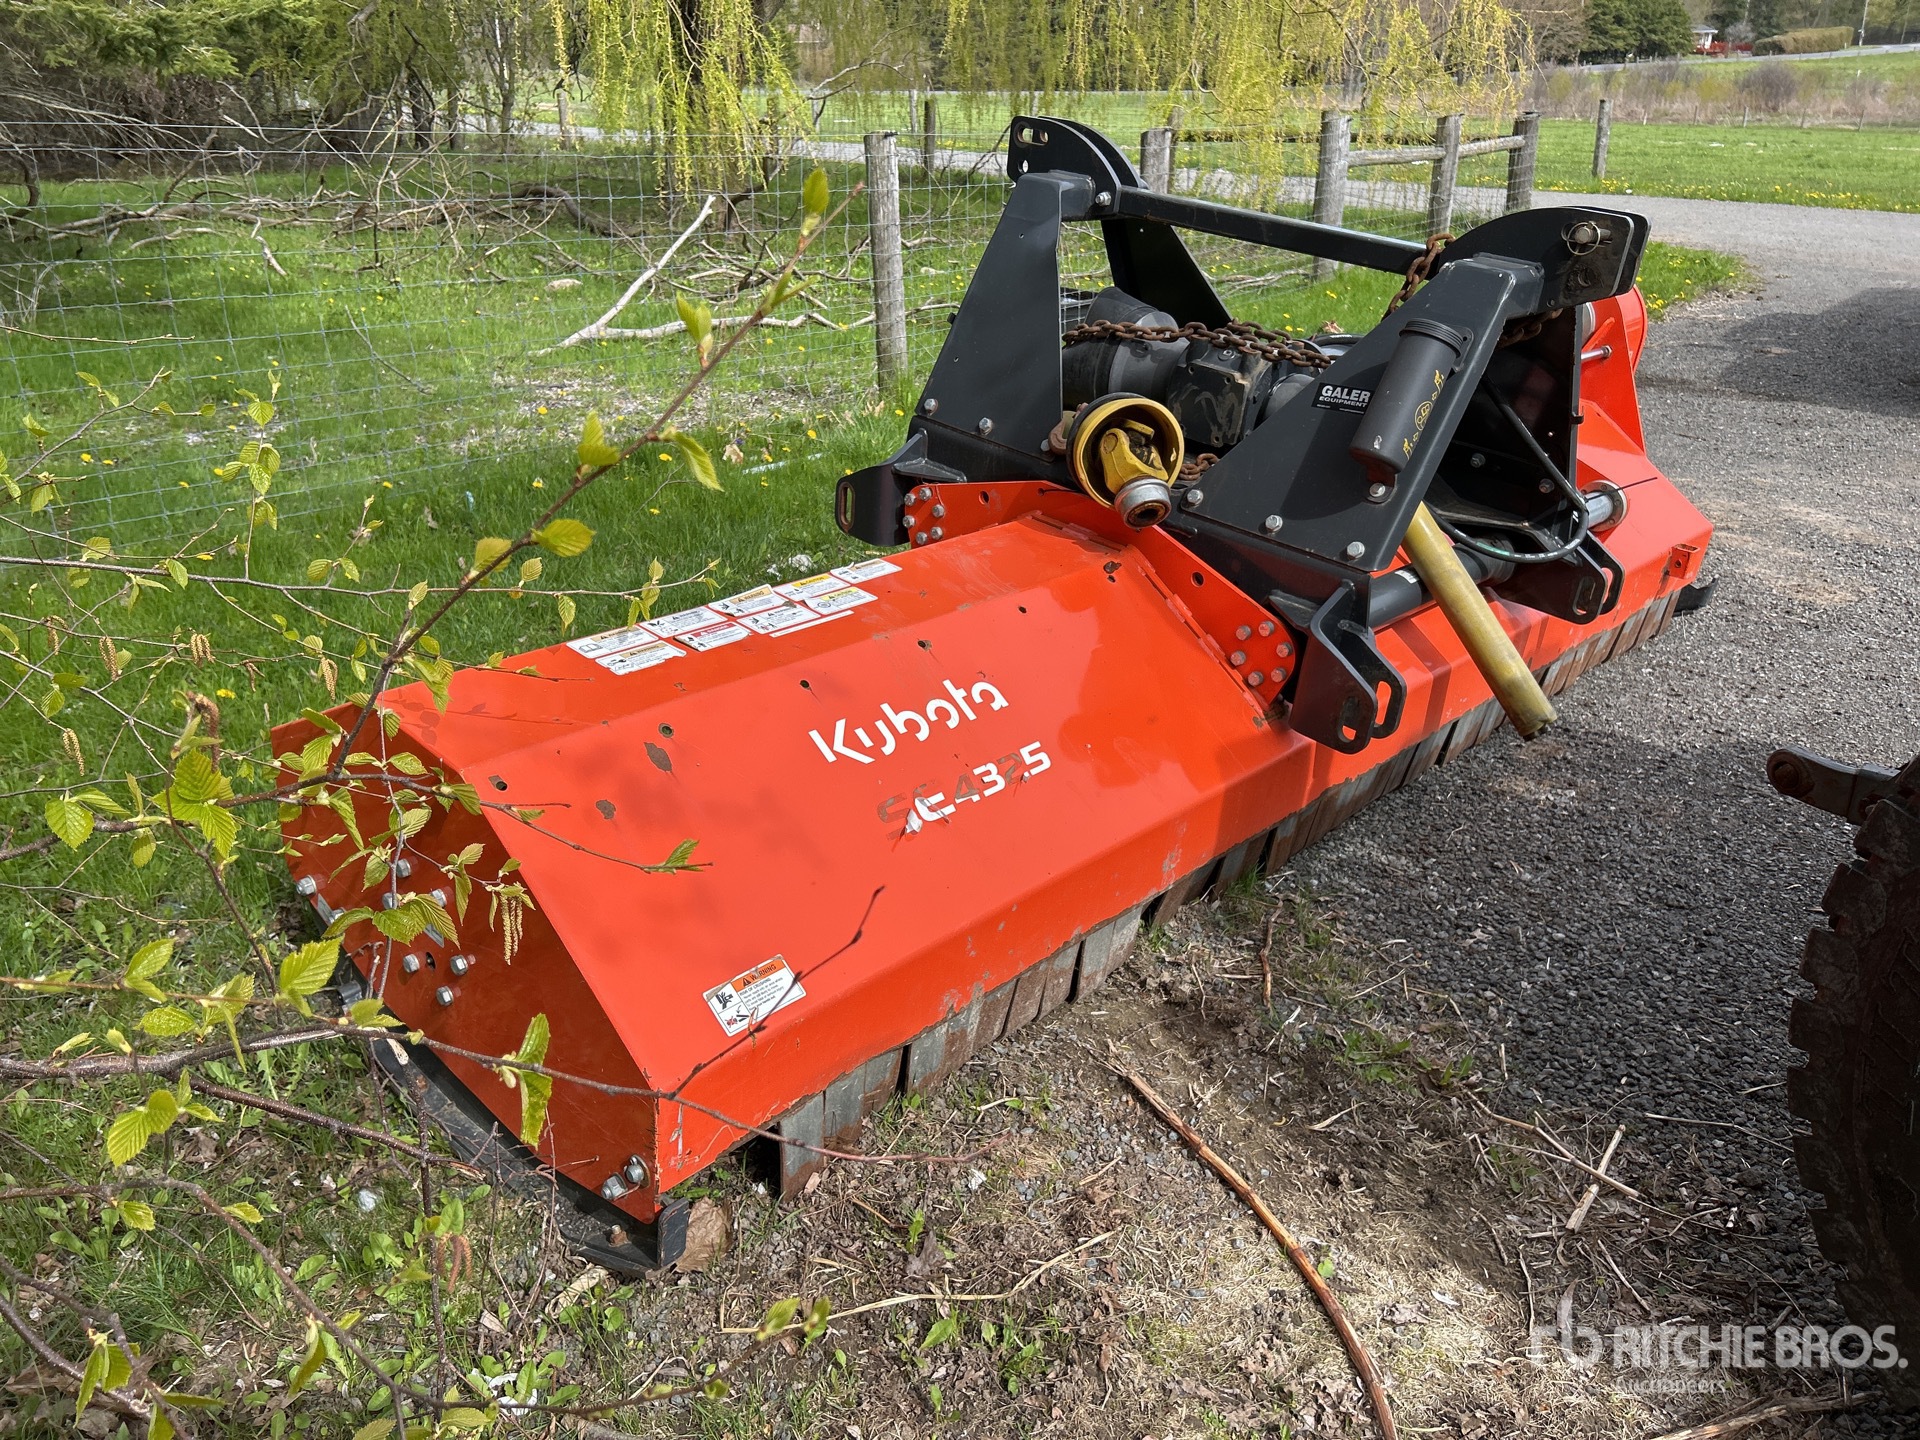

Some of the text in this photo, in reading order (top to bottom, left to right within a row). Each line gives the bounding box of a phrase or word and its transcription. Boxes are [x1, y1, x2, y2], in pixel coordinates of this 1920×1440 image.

[1319, 396, 1367, 407] EQUIPMENT
[1322, 385, 1370, 402] GALER
[808, 679, 1009, 764] Kubota
